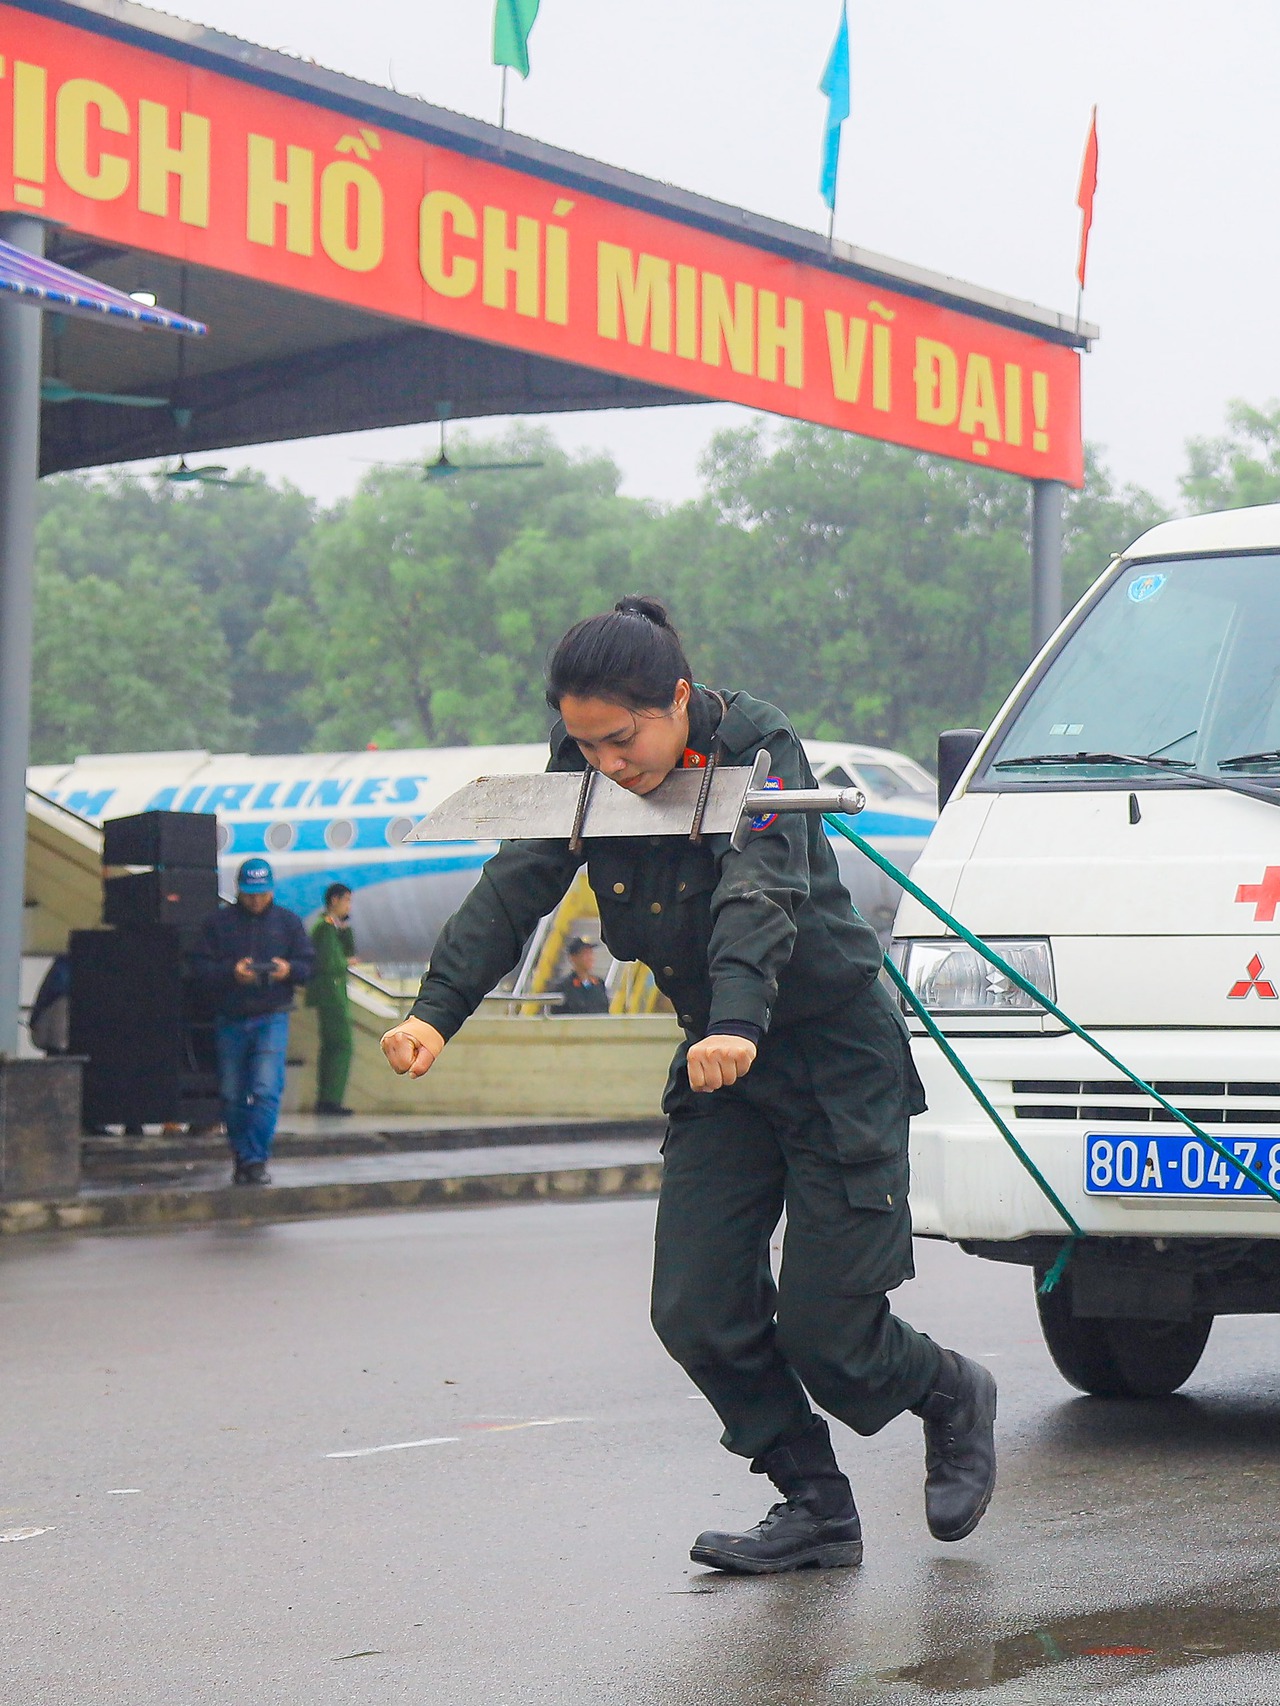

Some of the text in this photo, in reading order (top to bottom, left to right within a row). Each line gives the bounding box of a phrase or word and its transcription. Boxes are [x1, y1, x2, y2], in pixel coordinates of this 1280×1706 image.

[0, 55, 1049, 456] ỊCH HỒ CHÍ MINH VĨ ĐẠI!
[144, 775, 429, 813] AIRLINES
